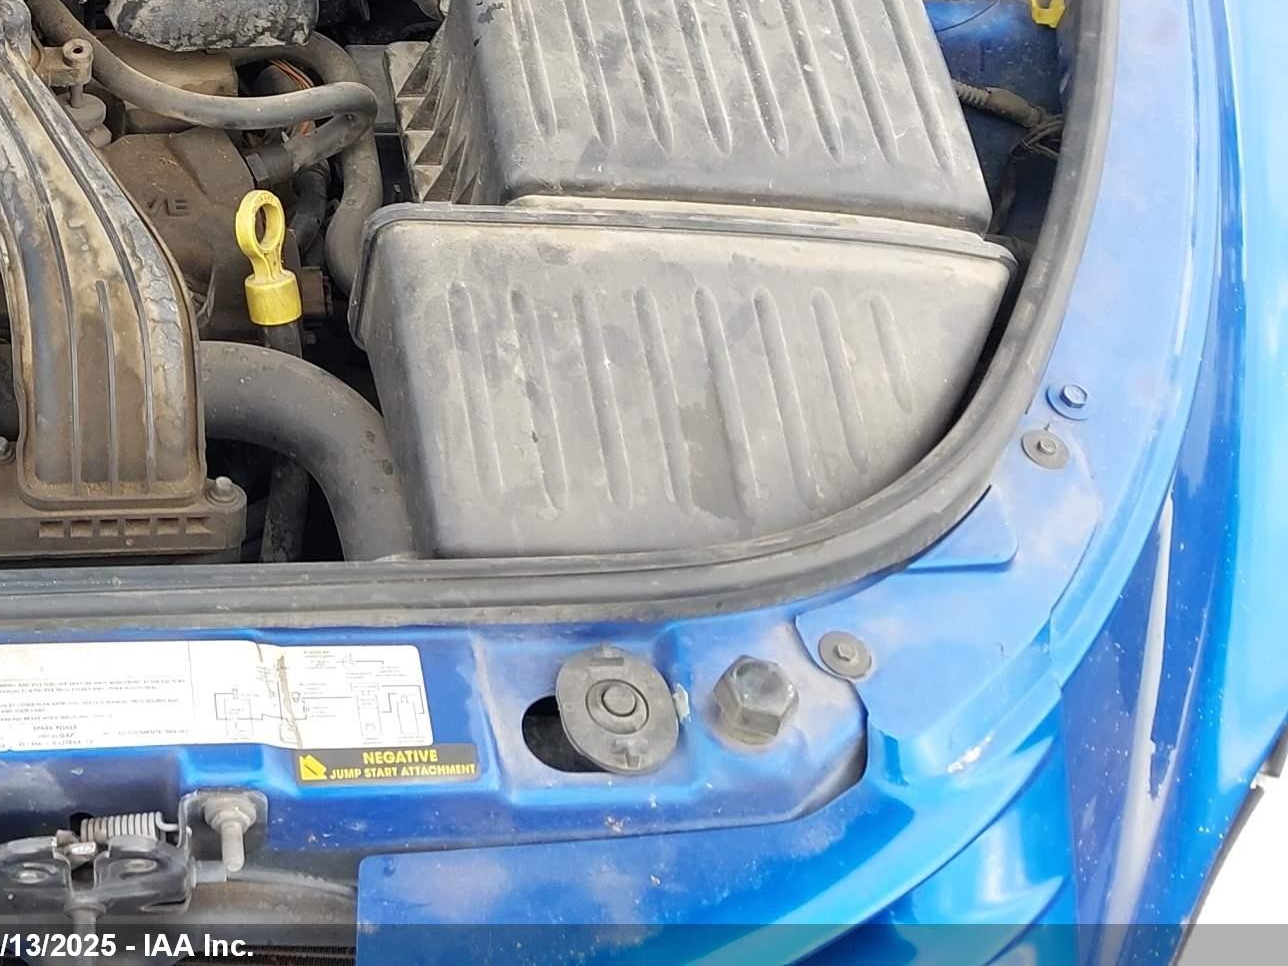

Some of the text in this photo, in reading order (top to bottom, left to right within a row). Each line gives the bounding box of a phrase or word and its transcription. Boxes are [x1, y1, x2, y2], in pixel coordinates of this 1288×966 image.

[362, 749, 438, 765] NEGATIVE
[329, 764, 476, 780] JUMP START ATTACHMENT
